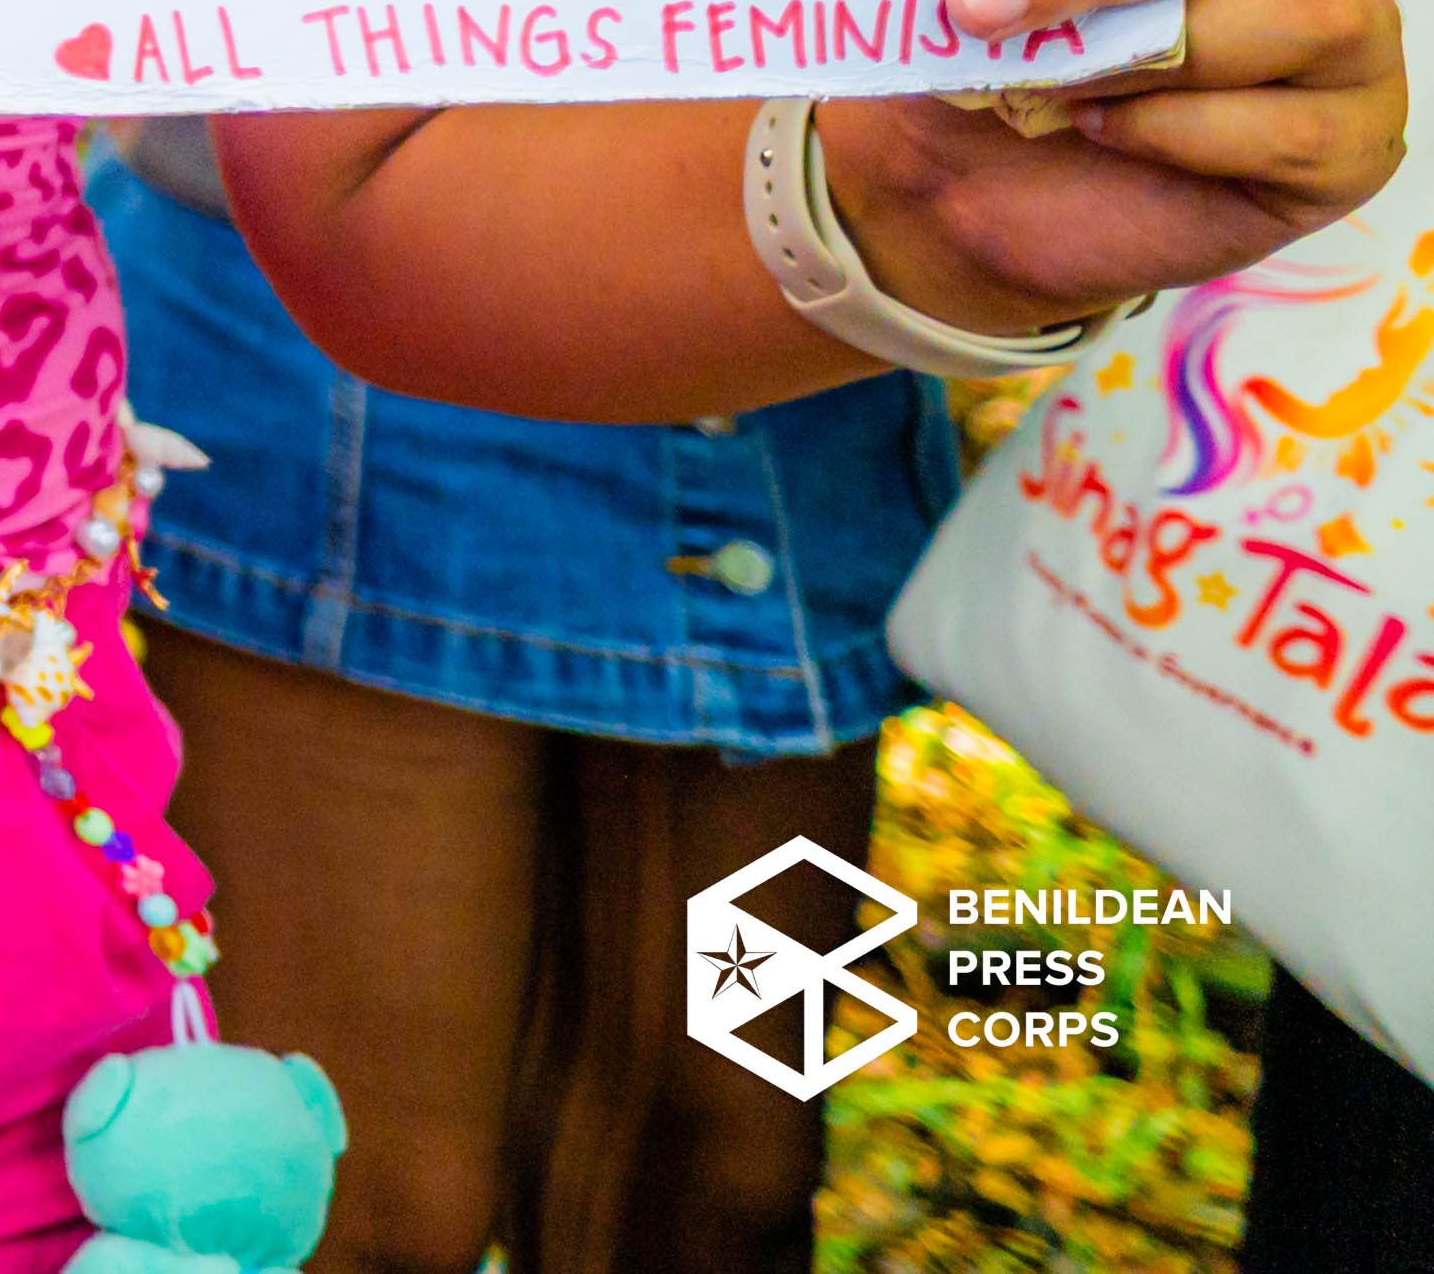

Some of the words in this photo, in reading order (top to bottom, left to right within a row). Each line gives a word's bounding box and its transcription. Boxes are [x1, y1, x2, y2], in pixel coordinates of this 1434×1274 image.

[133, 6, 262, 85] ALL
[301, 3, 623, 78] THINGS
[1017, 395, 1221, 630] Sinag
